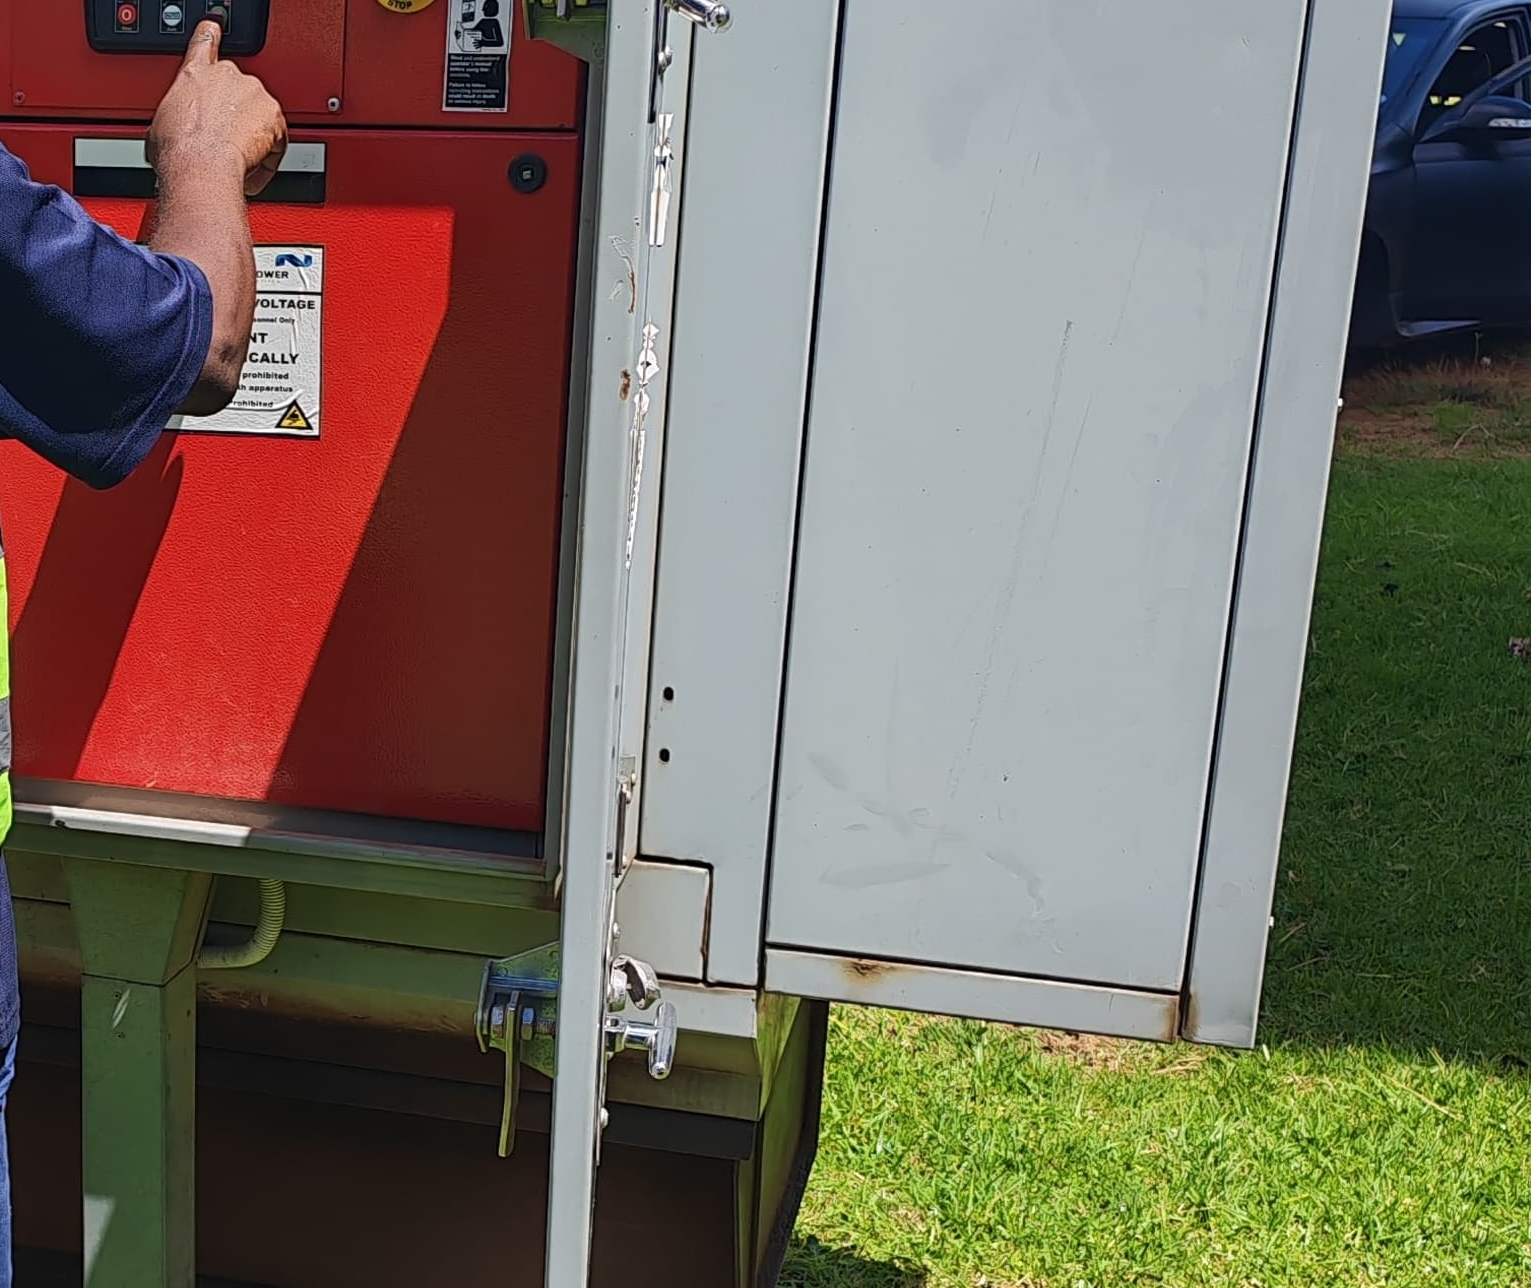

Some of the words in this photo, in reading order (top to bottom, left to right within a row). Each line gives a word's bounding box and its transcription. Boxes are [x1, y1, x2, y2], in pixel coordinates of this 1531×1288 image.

[255, 270, 289, 279] OWER
[279, 317, 295, 325] Only
[248, 352, 299, 364] CALLY
[242, 372, 289, 380] prohibited
[233, 400, 273, 408] rohibited
